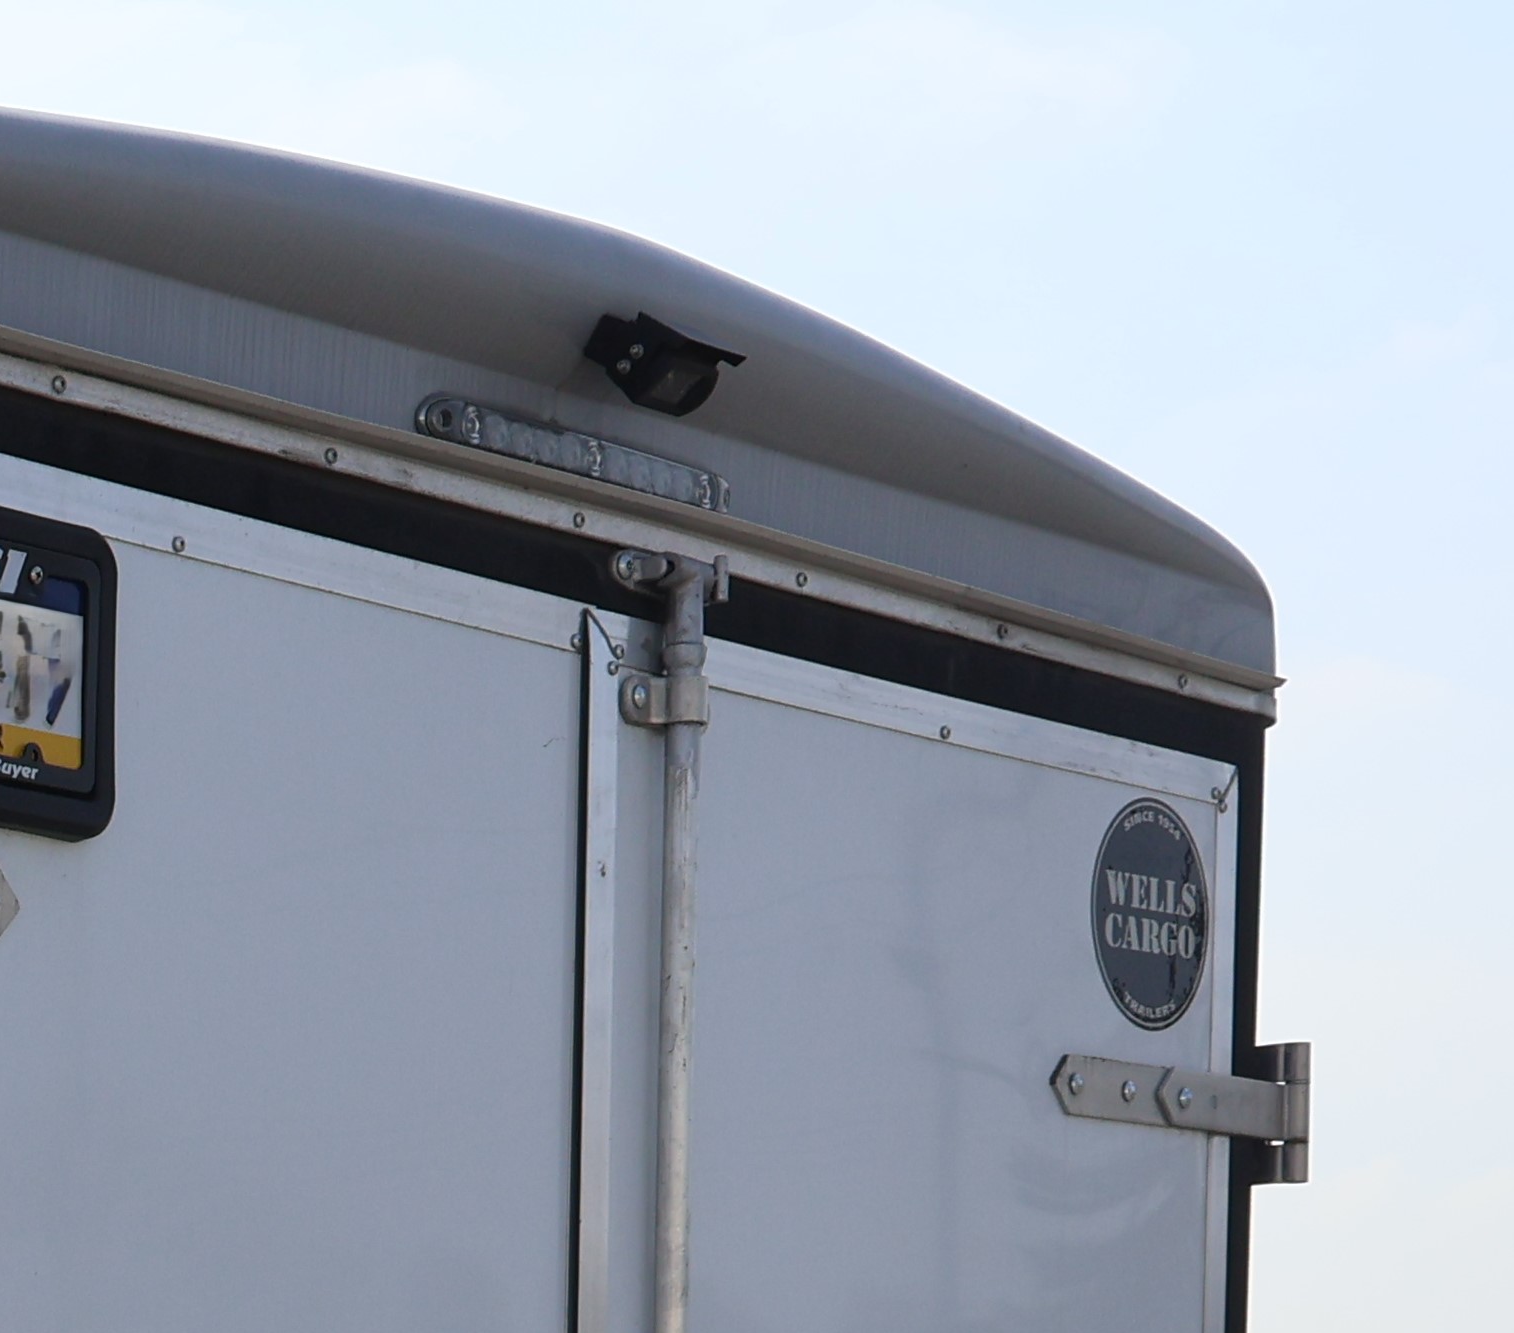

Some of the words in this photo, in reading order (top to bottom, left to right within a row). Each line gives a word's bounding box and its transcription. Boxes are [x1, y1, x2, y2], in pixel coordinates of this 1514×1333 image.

[1123, 811, 1154, 831] SINCE
[1106, 869, 1197, 918] WELLS
[1104, 912, 1196, 959] CARGO
